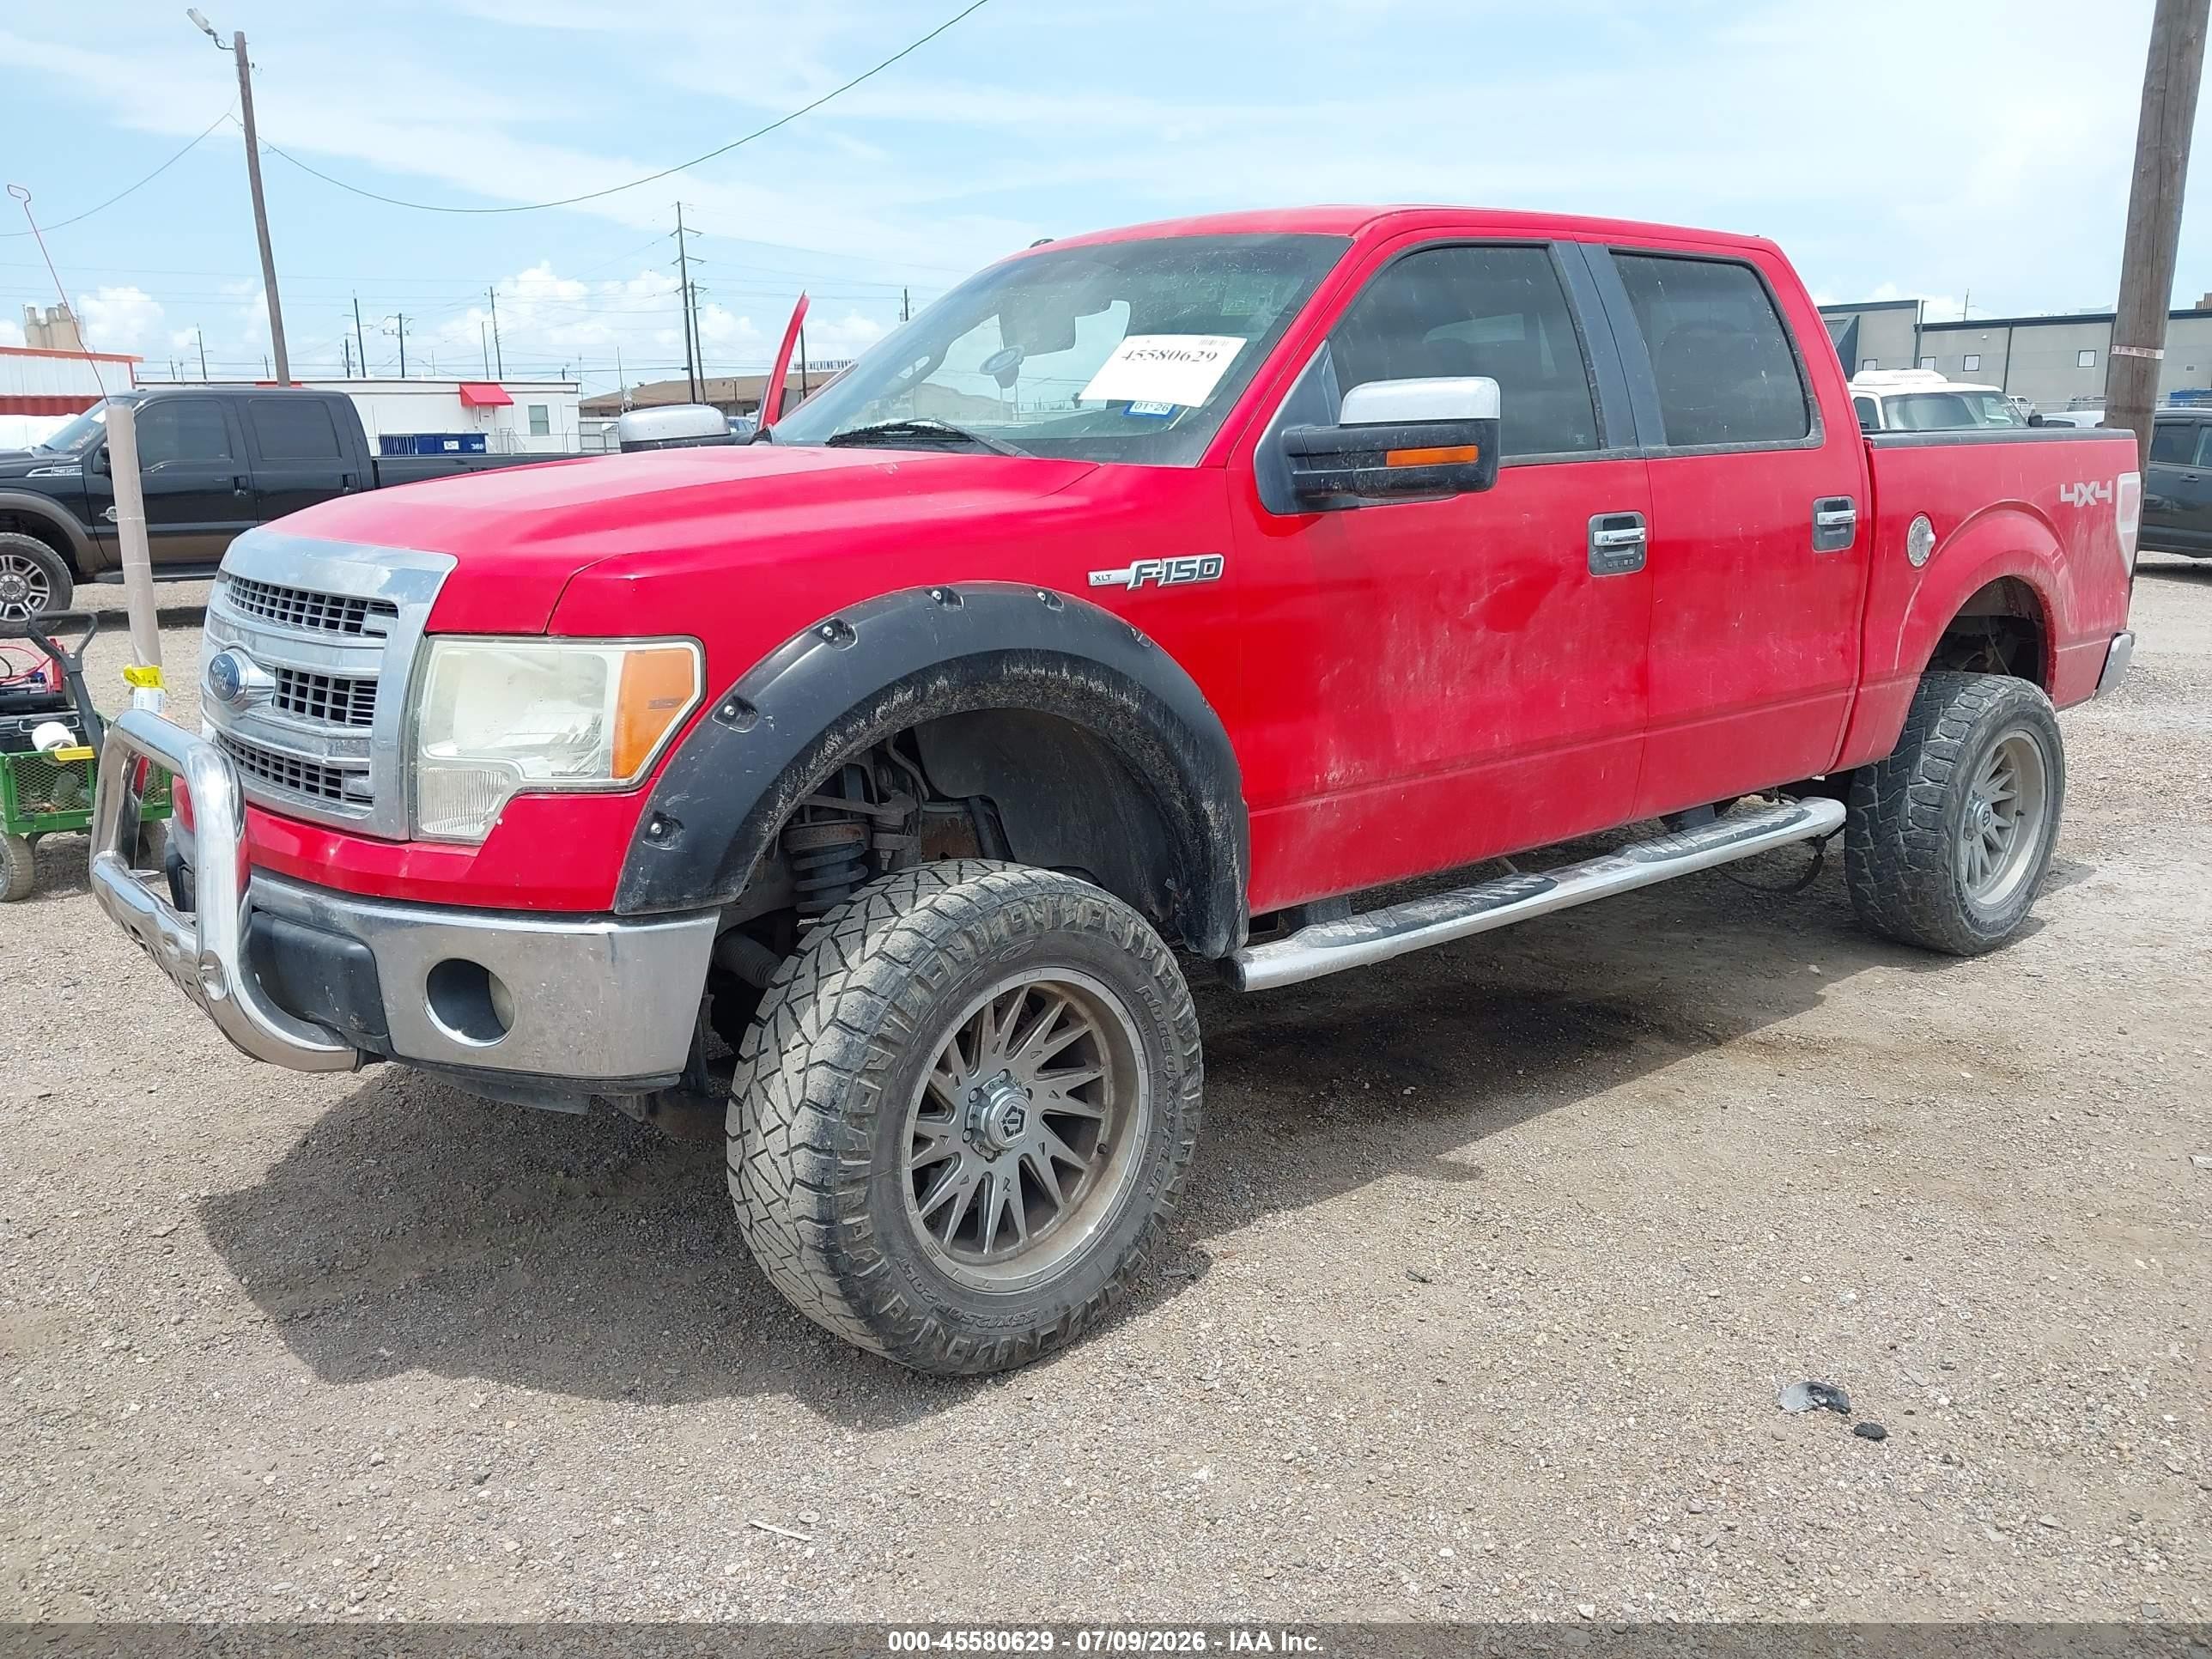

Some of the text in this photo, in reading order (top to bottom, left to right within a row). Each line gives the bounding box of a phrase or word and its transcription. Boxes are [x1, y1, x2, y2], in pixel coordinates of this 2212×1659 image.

[1121, 349, 1218, 363] 45580629
[1094, 556, 1224, 589] XLT F-150
[209, 659, 231, 691] Ford
[1134, 984, 1176, 1054] RIDGE
